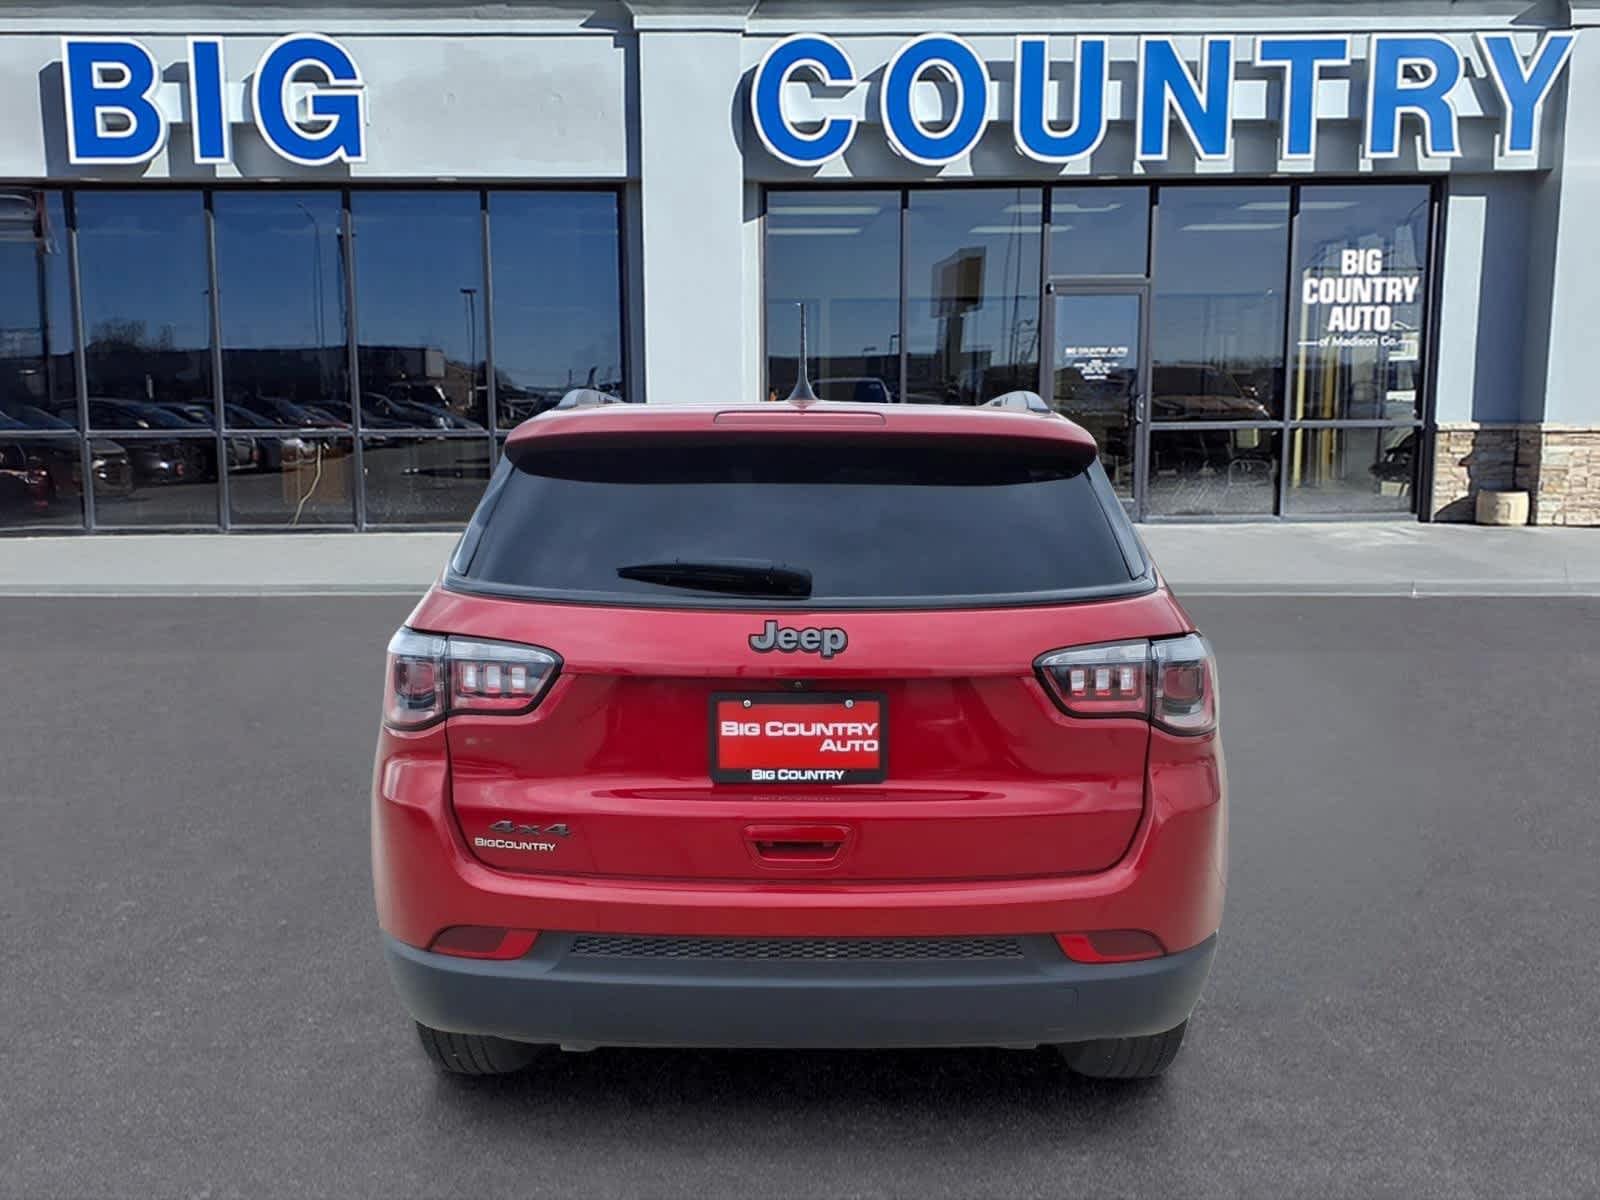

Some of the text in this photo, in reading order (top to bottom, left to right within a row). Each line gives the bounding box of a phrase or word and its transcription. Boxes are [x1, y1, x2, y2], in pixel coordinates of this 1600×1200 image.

[61, 32, 1575, 168] BIG COUNTRY
[1341, 248, 1383, 276] BIG
[1302, 276, 1420, 304] COUNTRY
[1327, 305, 1392, 333] AUTO
[1319, 335, 1330, 347] of
[1331, 335, 1378, 347] Madison
[748, 619, 848, 658] Jeep
[488, 820, 571, 837] 4x4
